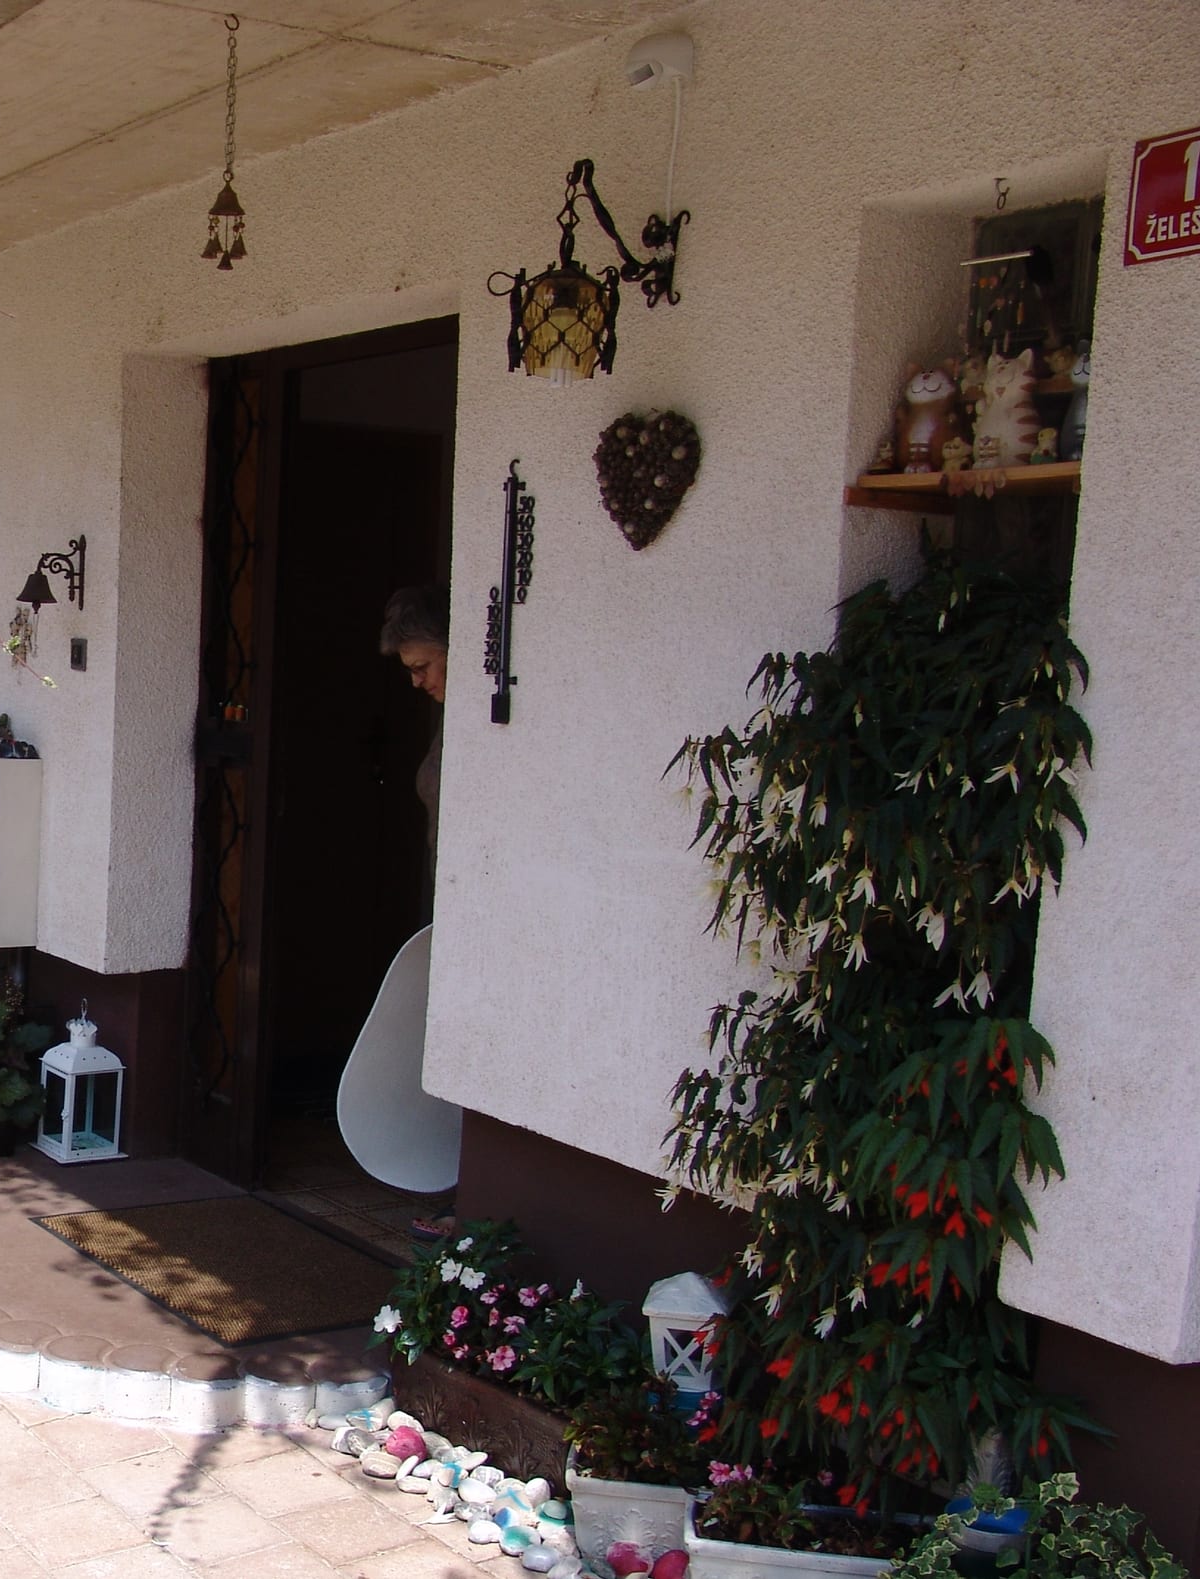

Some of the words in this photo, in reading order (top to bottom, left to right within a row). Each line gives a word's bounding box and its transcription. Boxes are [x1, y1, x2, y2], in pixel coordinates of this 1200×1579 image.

[517, 569, 532, 585] 10
[490, 587, 499, 601] 0
[517, 587, 527, 601] 0
